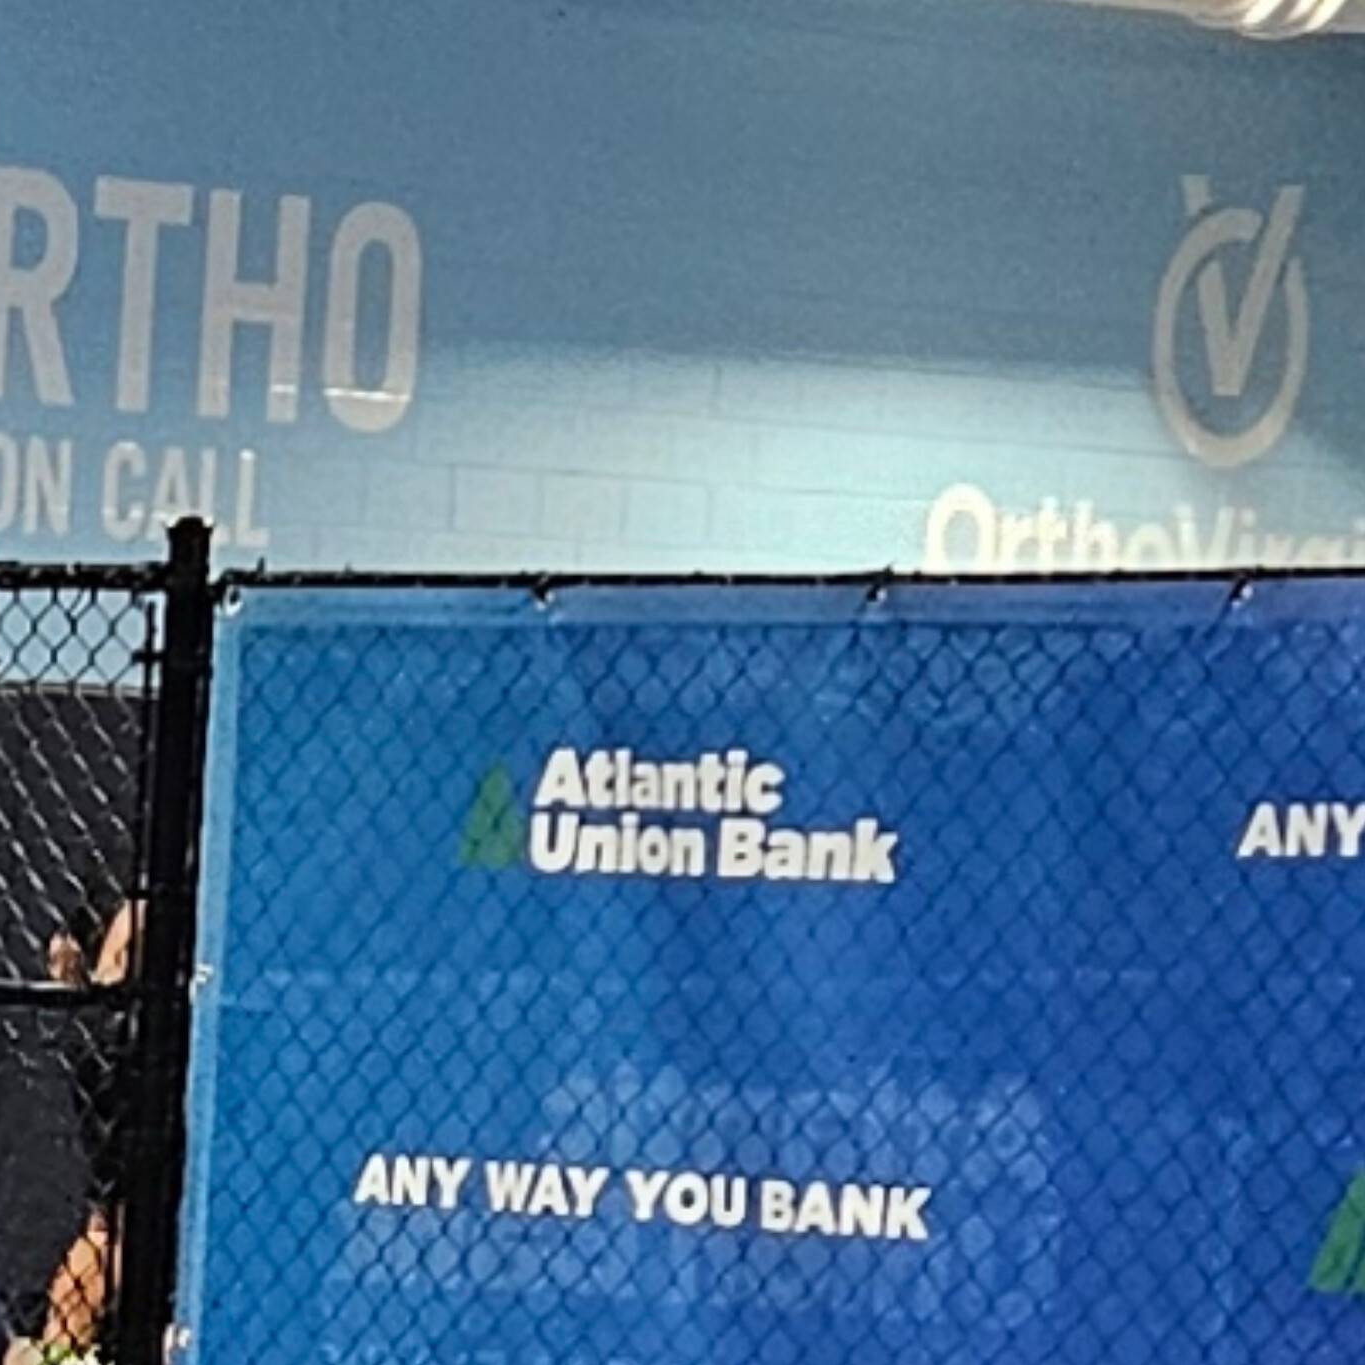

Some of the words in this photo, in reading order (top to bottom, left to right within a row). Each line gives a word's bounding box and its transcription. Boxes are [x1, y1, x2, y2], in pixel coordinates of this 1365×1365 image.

[101, 440, 269, 548] CALL
[534, 747, 784, 813] Atlantic
[530, 812, 705, 876] Union
[717, 818, 898, 883] Bank
[1236, 801, 1365, 857] ANY
[354, 1153, 470, 1209] ANY
[485, 1160, 609, 1218] WAY
[625, 1170, 746, 1227] YOU
[759, 1179, 931, 1240] BANK
